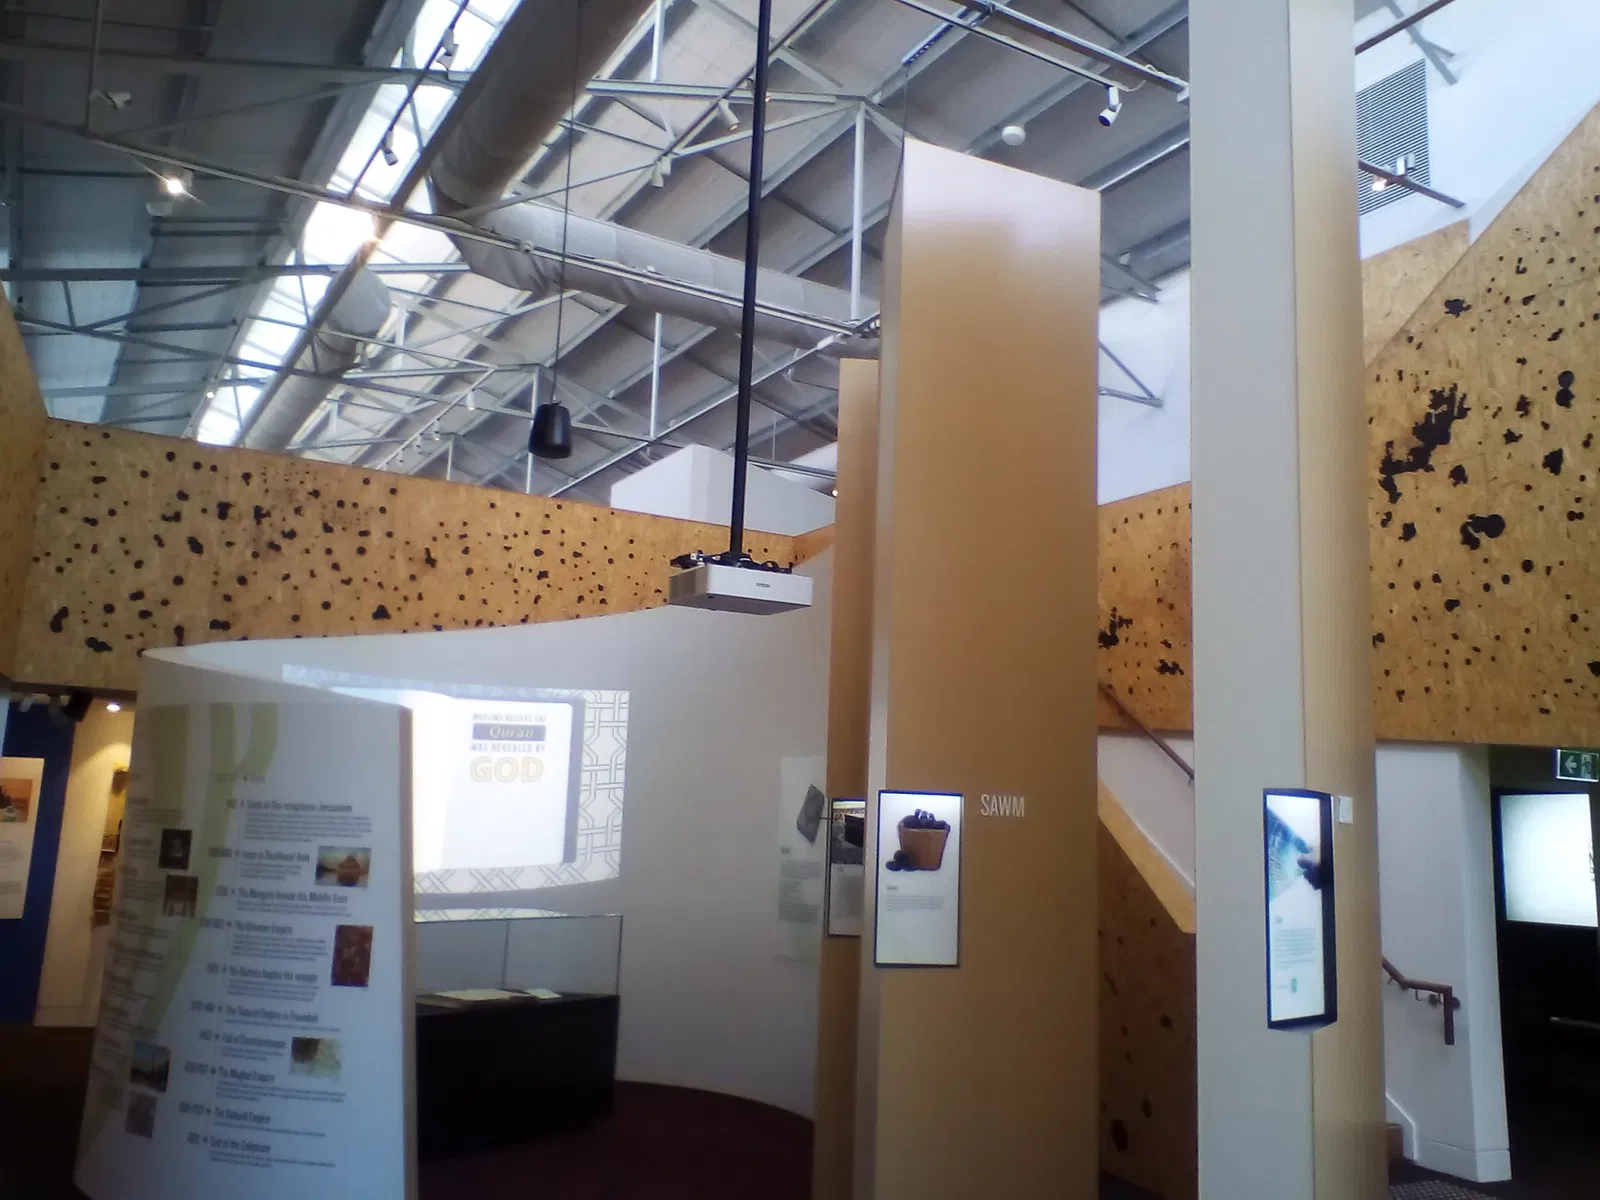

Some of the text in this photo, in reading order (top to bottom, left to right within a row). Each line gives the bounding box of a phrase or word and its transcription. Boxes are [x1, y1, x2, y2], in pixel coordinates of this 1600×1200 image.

[471, 743, 546, 752] WAS REVEALED BY
[469, 756, 544, 783] GOD
[980, 794, 1025, 818] SAWM
